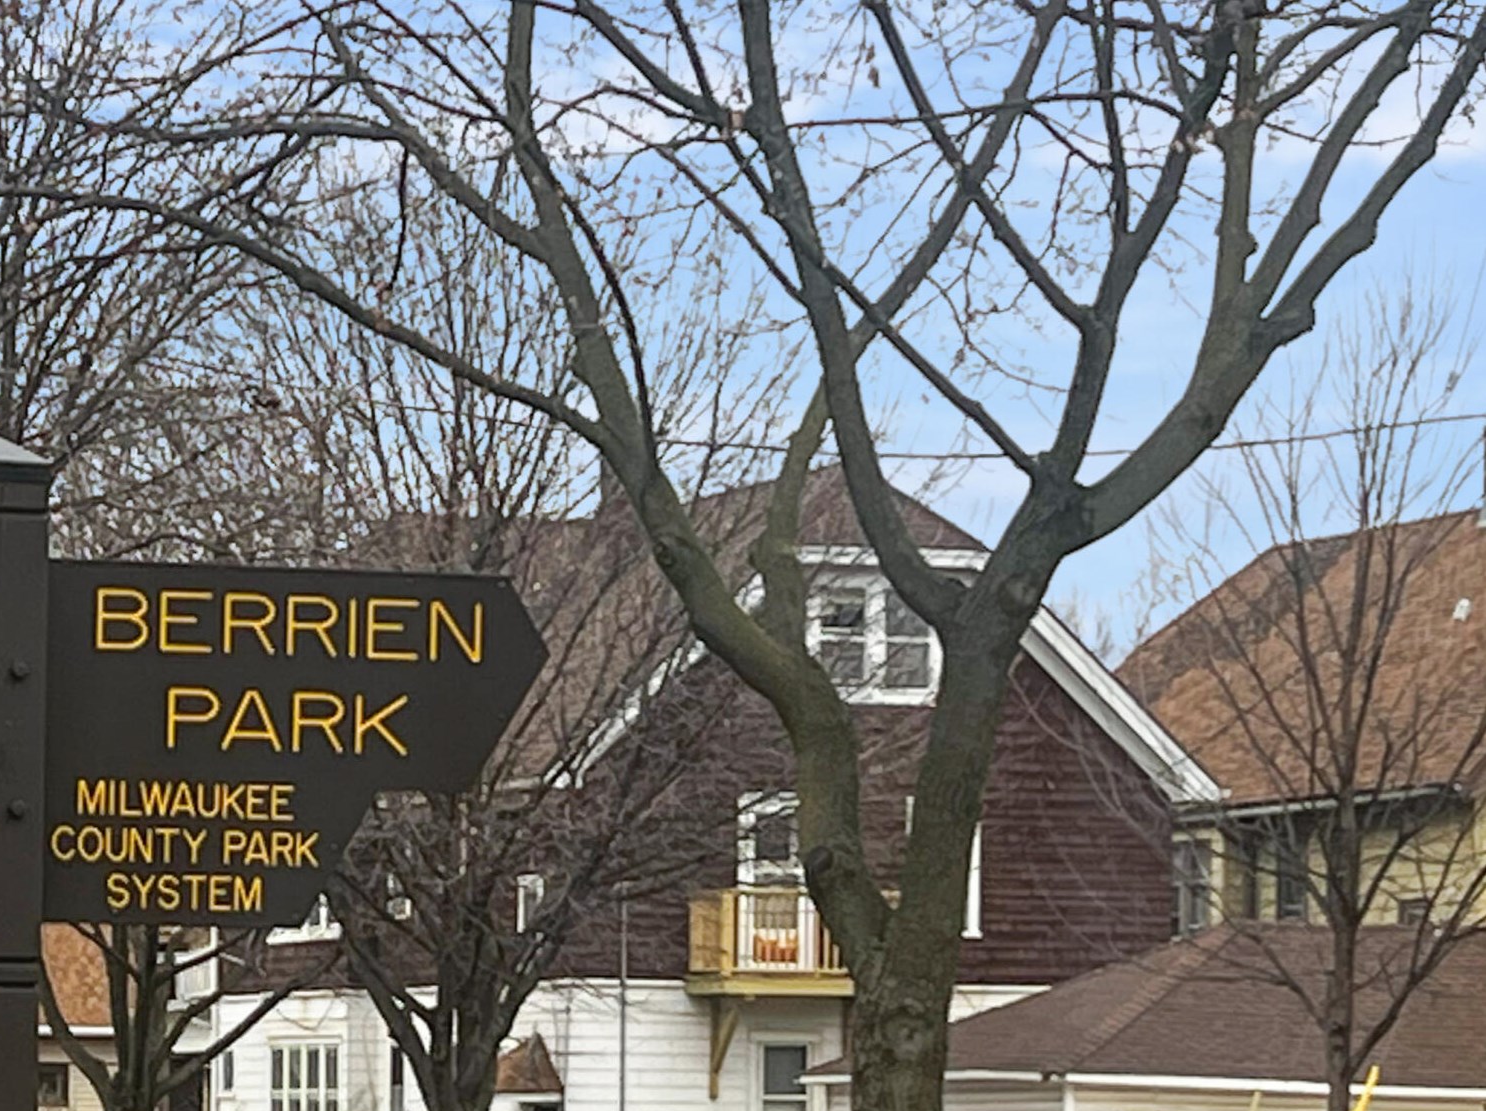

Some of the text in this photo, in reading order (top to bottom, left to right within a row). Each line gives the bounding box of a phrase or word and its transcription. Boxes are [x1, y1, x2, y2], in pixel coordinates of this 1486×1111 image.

[95, 587, 484, 663] BERRIEN
[166, 686, 410, 756] PARK
[76, 779, 295, 822] MILWAUKEE
[50, 825, 320, 868] COUNTY PARK
[105, 872, 264, 913] SYSTEM
